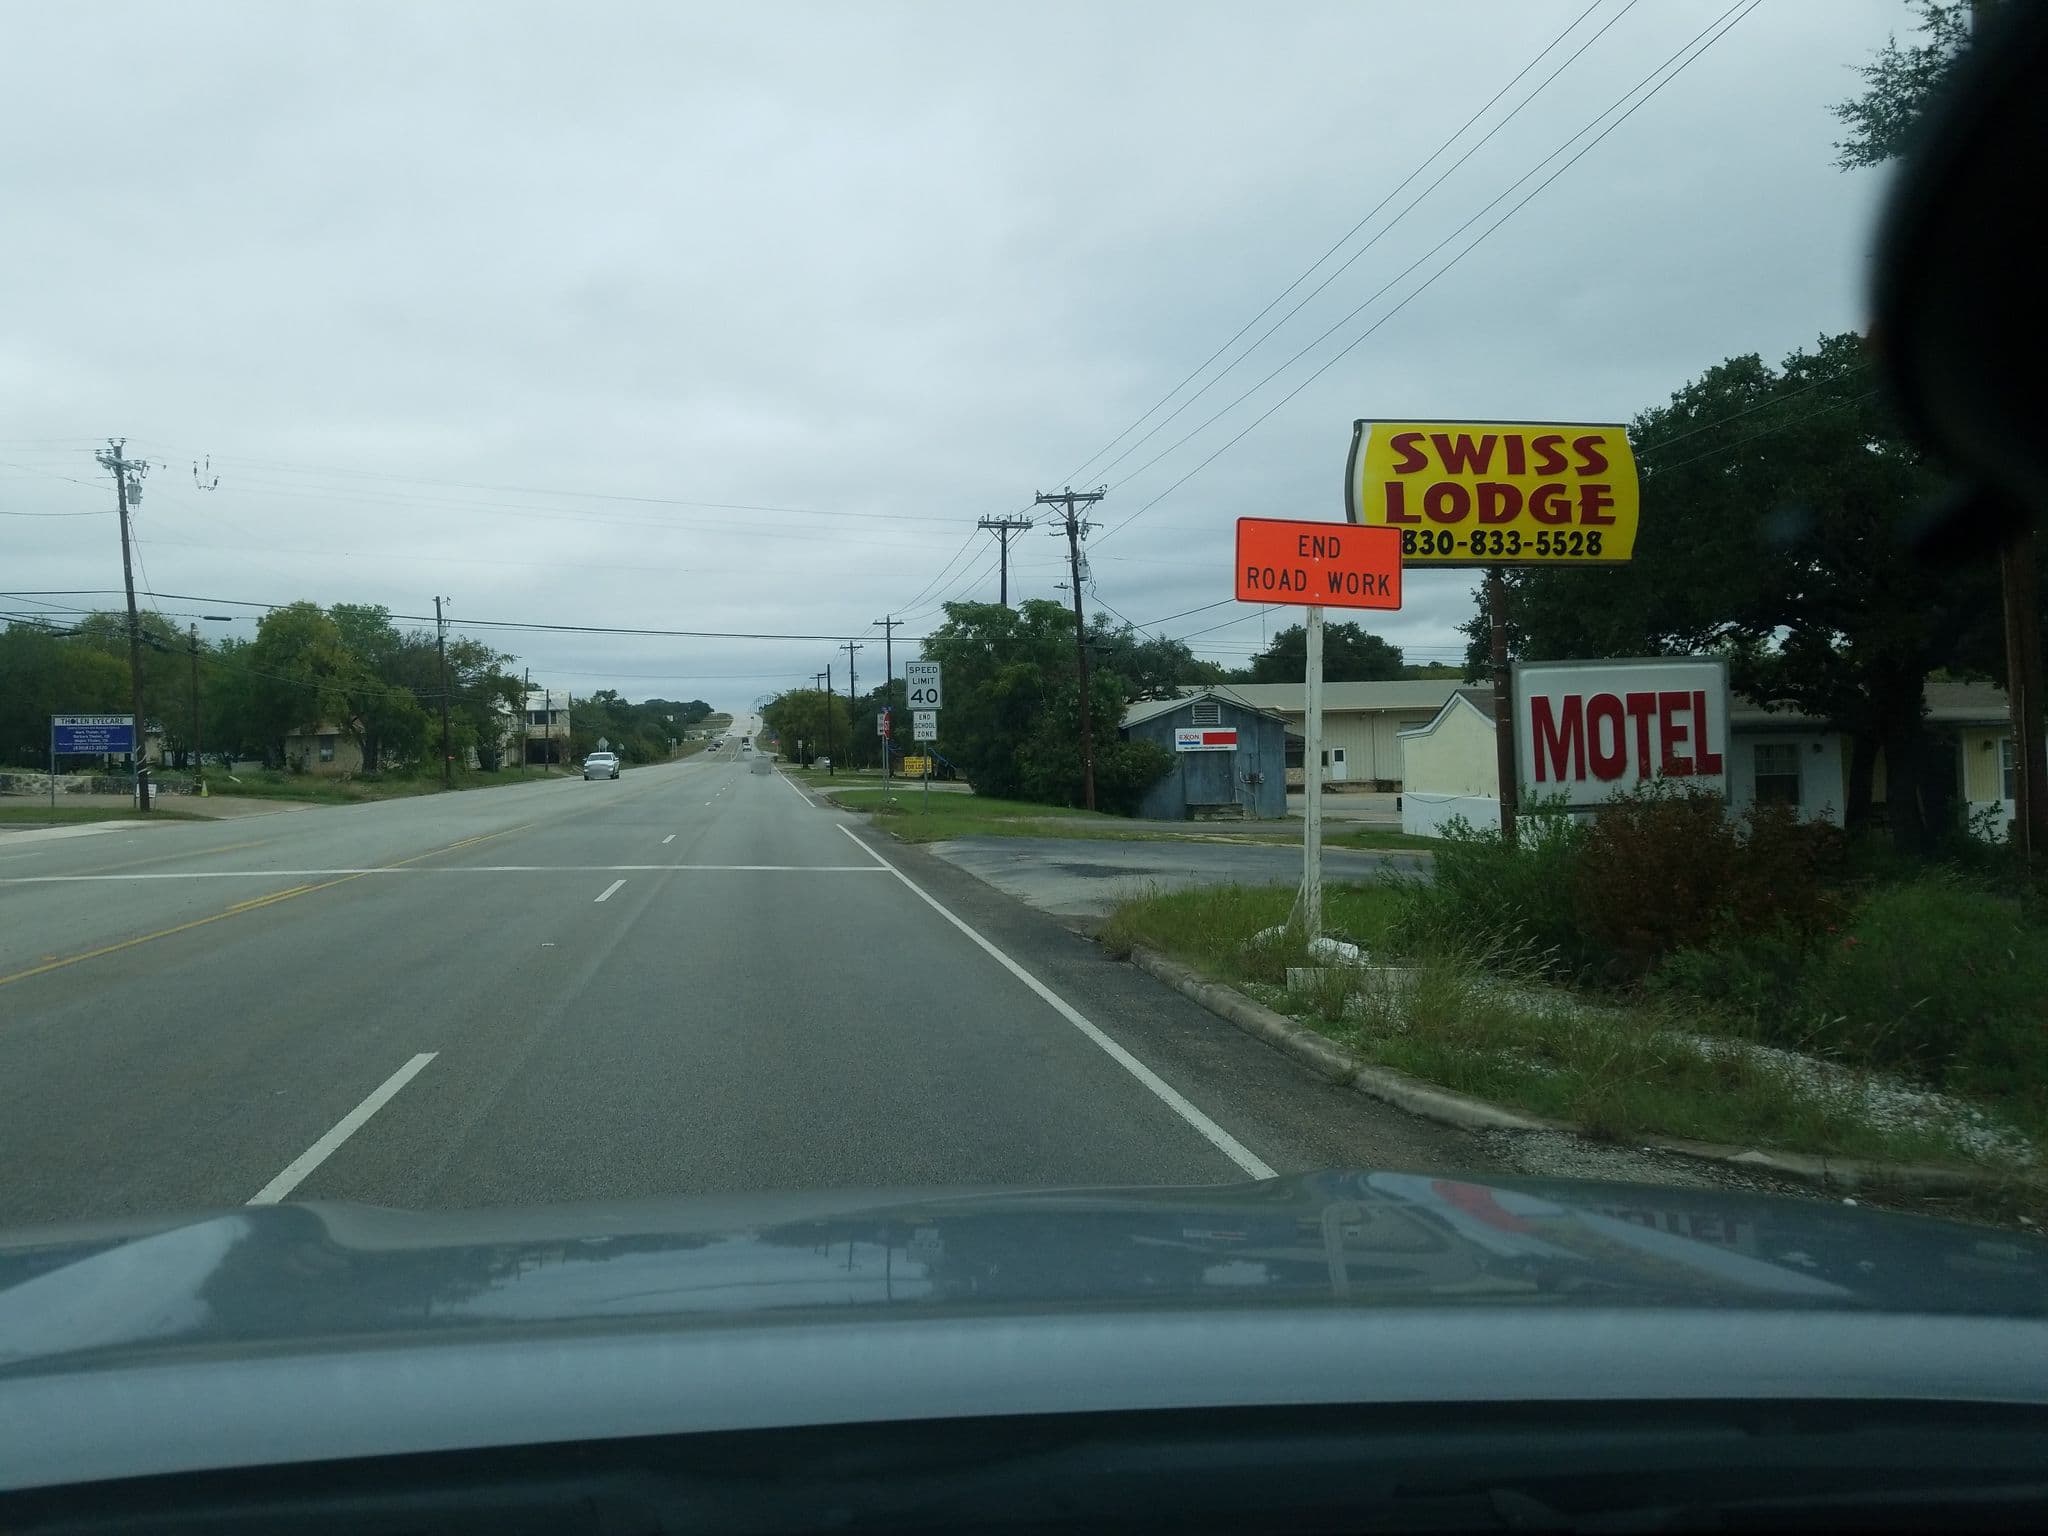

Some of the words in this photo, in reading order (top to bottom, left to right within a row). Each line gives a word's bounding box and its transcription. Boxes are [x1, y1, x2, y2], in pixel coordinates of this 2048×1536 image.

[1390, 432, 1609, 476] SWISS
[1385, 481, 1616, 525] LODGE
[1299, 535, 1341, 558] END
[1402, 529, 1602, 556] 830-833-5528
[1247, 567, 1307, 591] ROAD
[1328, 571, 1390, 596] WORK
[910, 689, 938, 703] 40
[1531, 691, 1723, 782] MOTEL
